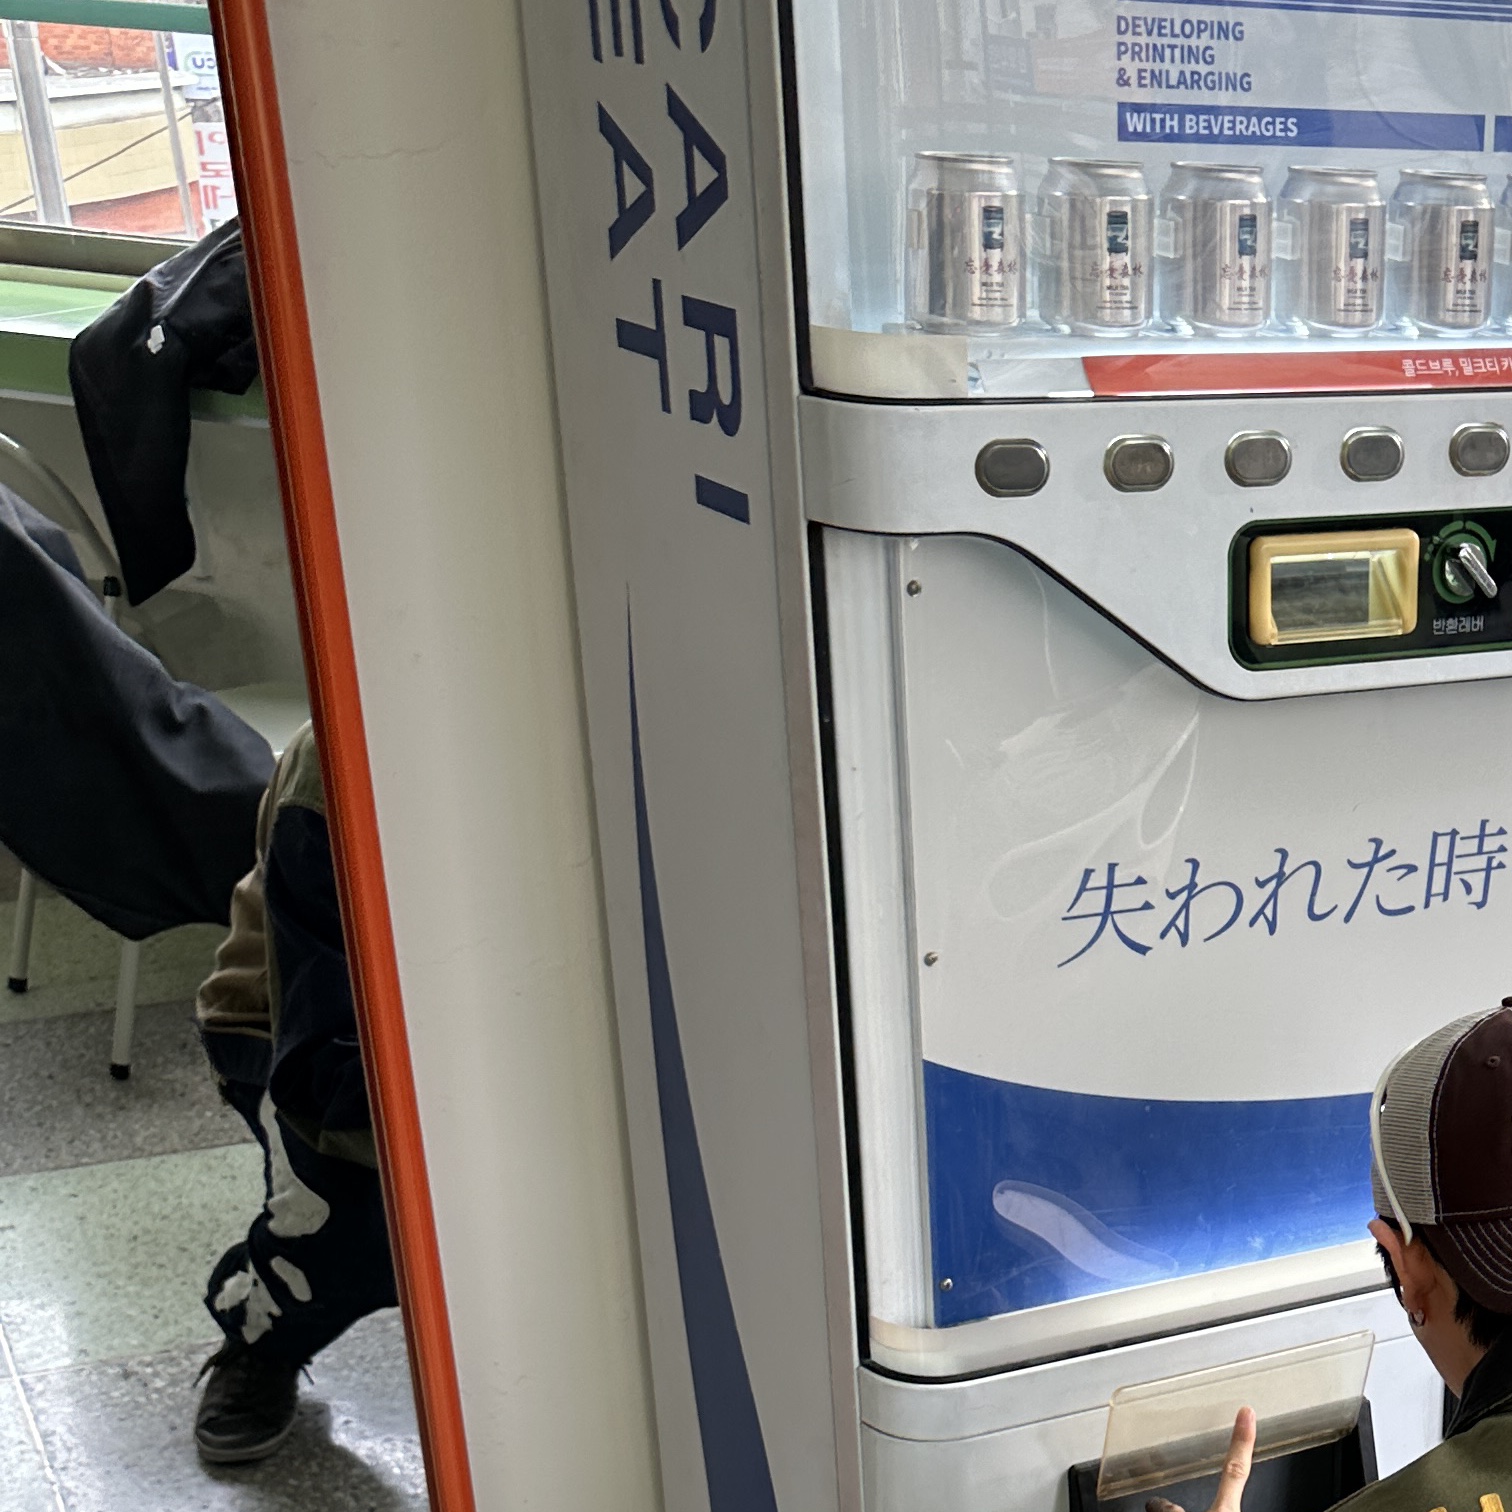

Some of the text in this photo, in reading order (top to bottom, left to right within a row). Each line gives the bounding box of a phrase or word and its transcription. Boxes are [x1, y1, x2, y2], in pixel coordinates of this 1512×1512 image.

[1116, 15, 1245, 42] DEVELOPING
[1116, 42, 1215, 66] PRINTING
[1115, 68, 1252, 93] & ENLARGING
[1126, 111, 1299, 138] WITH BEVERAGES
[1402, 358, 1459, 377] 콜드브루,
[1459, 357, 1500, 375] 밀크티
[1432, 615, 1485, 635] 반환레버
